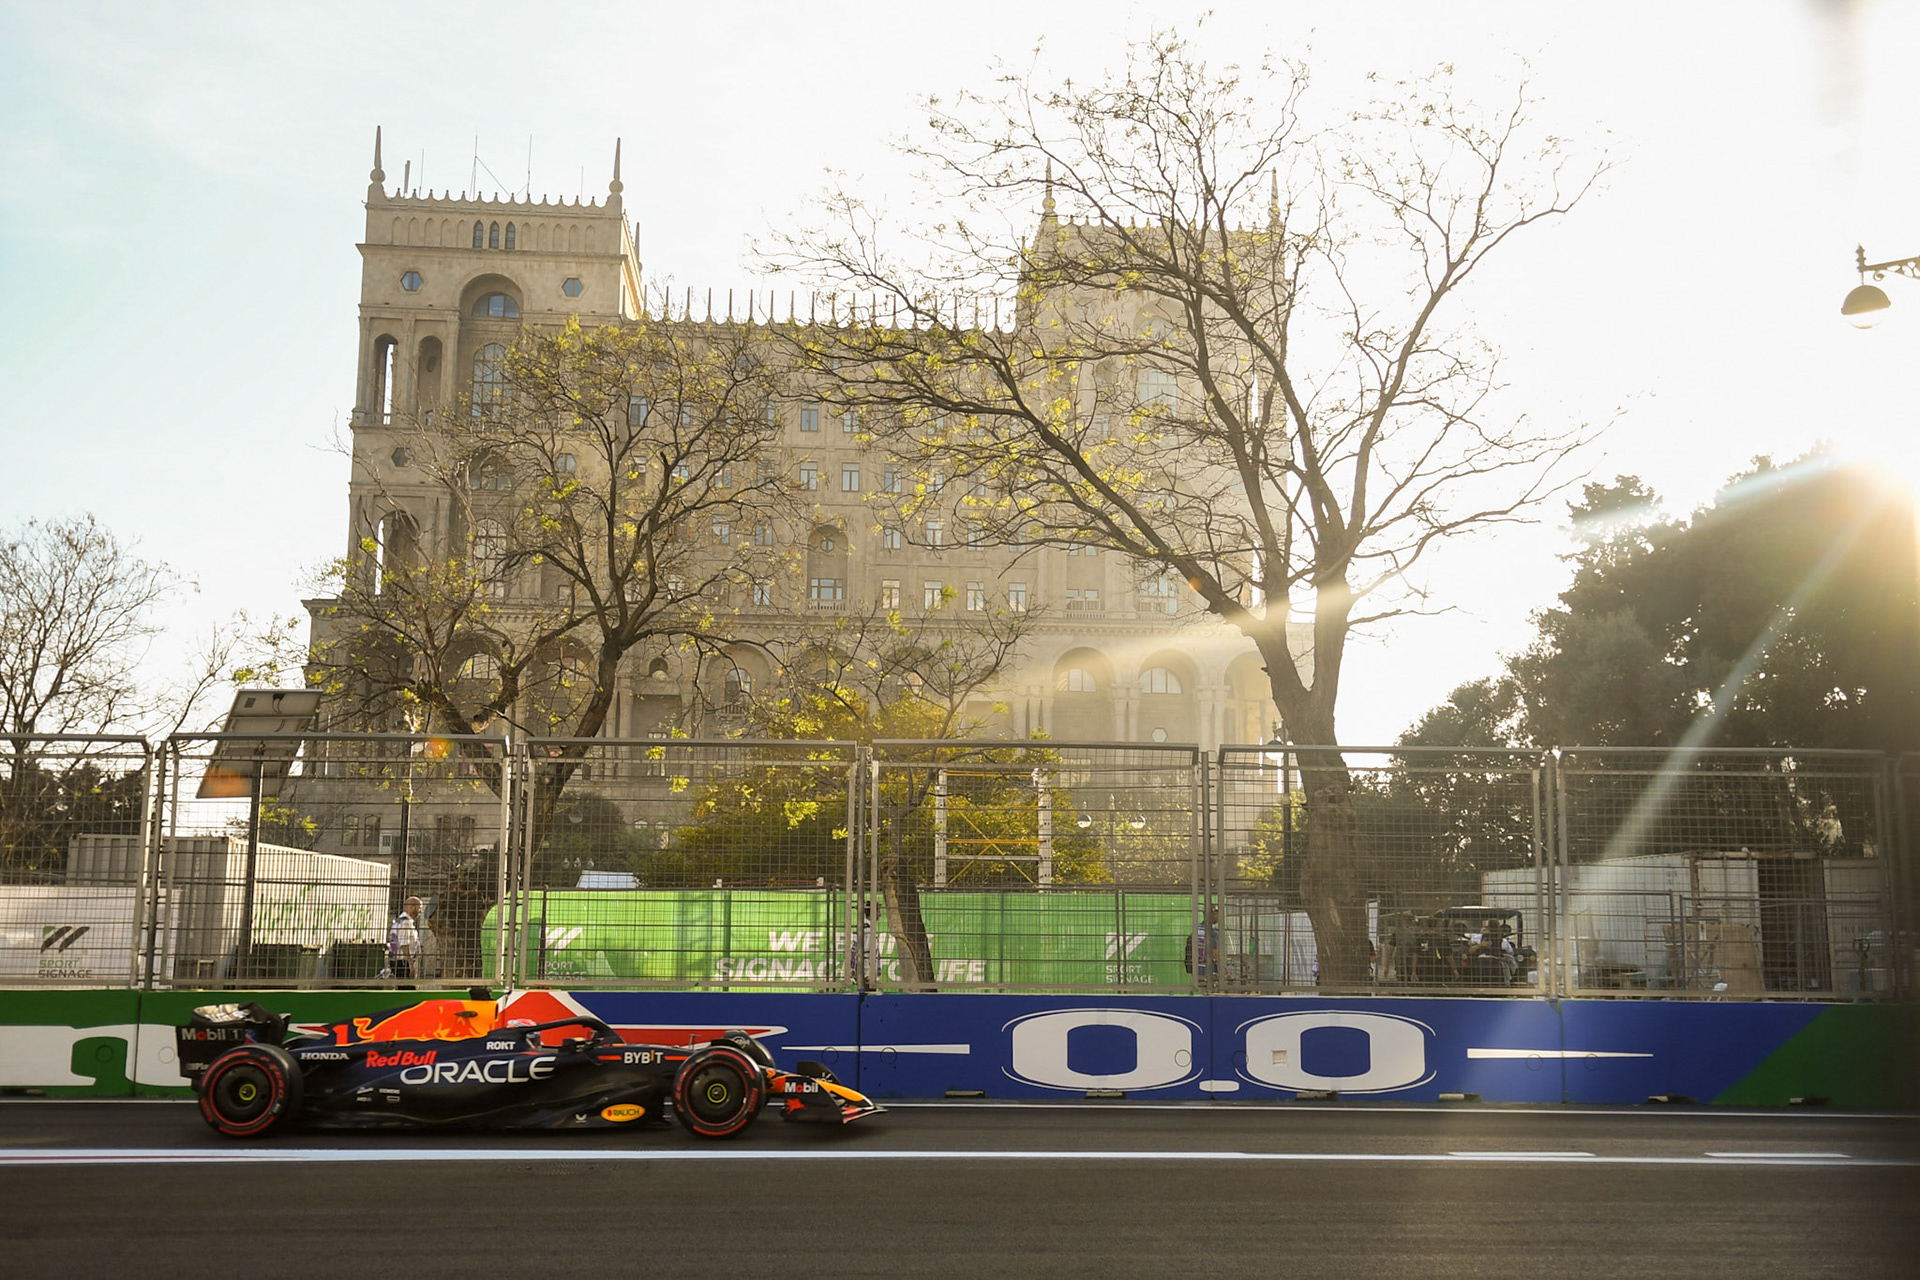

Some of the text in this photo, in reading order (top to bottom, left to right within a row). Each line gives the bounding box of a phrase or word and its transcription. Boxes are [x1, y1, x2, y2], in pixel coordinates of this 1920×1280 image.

[768, 931, 823, 953] WE
[39, 959, 79, 968] SPORT
[544, 960, 574, 971] PORT
[714, 957, 847, 982] SIGNAG
[935, 959, 987, 982] IFE
[37, 969, 92, 979] SIGNAGE
[544, 971, 587, 981] IGNAGE
[181, 1028, 226, 1041] Mobil
[333, 1023, 349, 1046] 1
[486, 1041, 517, 1051] ROKT
[300, 1052, 350, 1061] HONDA
[366, 1050, 438, 1068] Red Bull
[623, 1050, 664, 1065] BYBIT
[400, 1056, 557, 1085] ORACLE
[784, 1081, 819, 1093] Mobil
[612, 1108, 641, 1117] RAUCH
